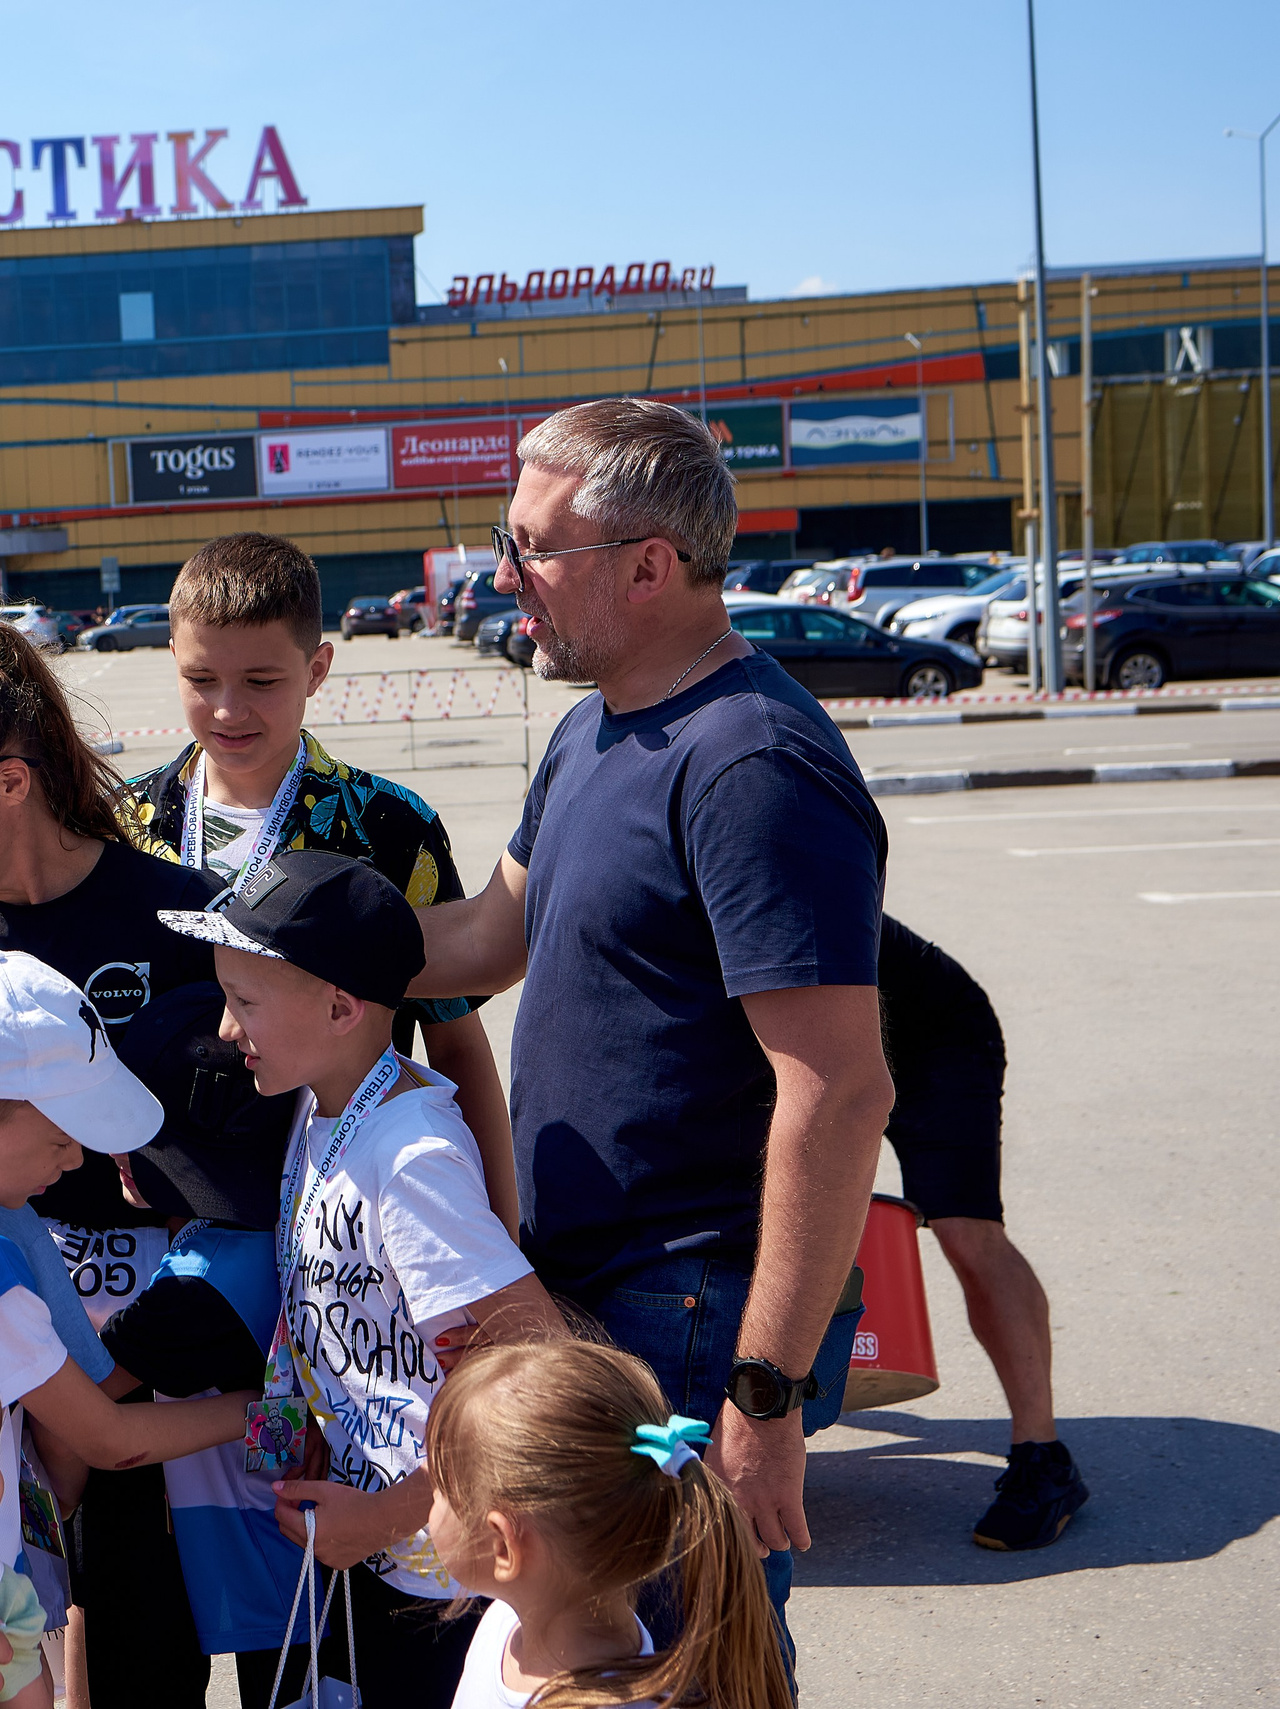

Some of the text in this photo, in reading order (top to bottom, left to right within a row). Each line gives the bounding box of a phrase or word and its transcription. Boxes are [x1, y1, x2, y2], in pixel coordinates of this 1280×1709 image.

[186, 787, 199, 868] ОРЕВНОВАНИЯ
[91, 989, 142, 998] VOLVO
[353, 1064, 393, 1114] СЕТЕВЫЕ
[302, 1114, 356, 1216] СОРЕВНОВАНИЯ
